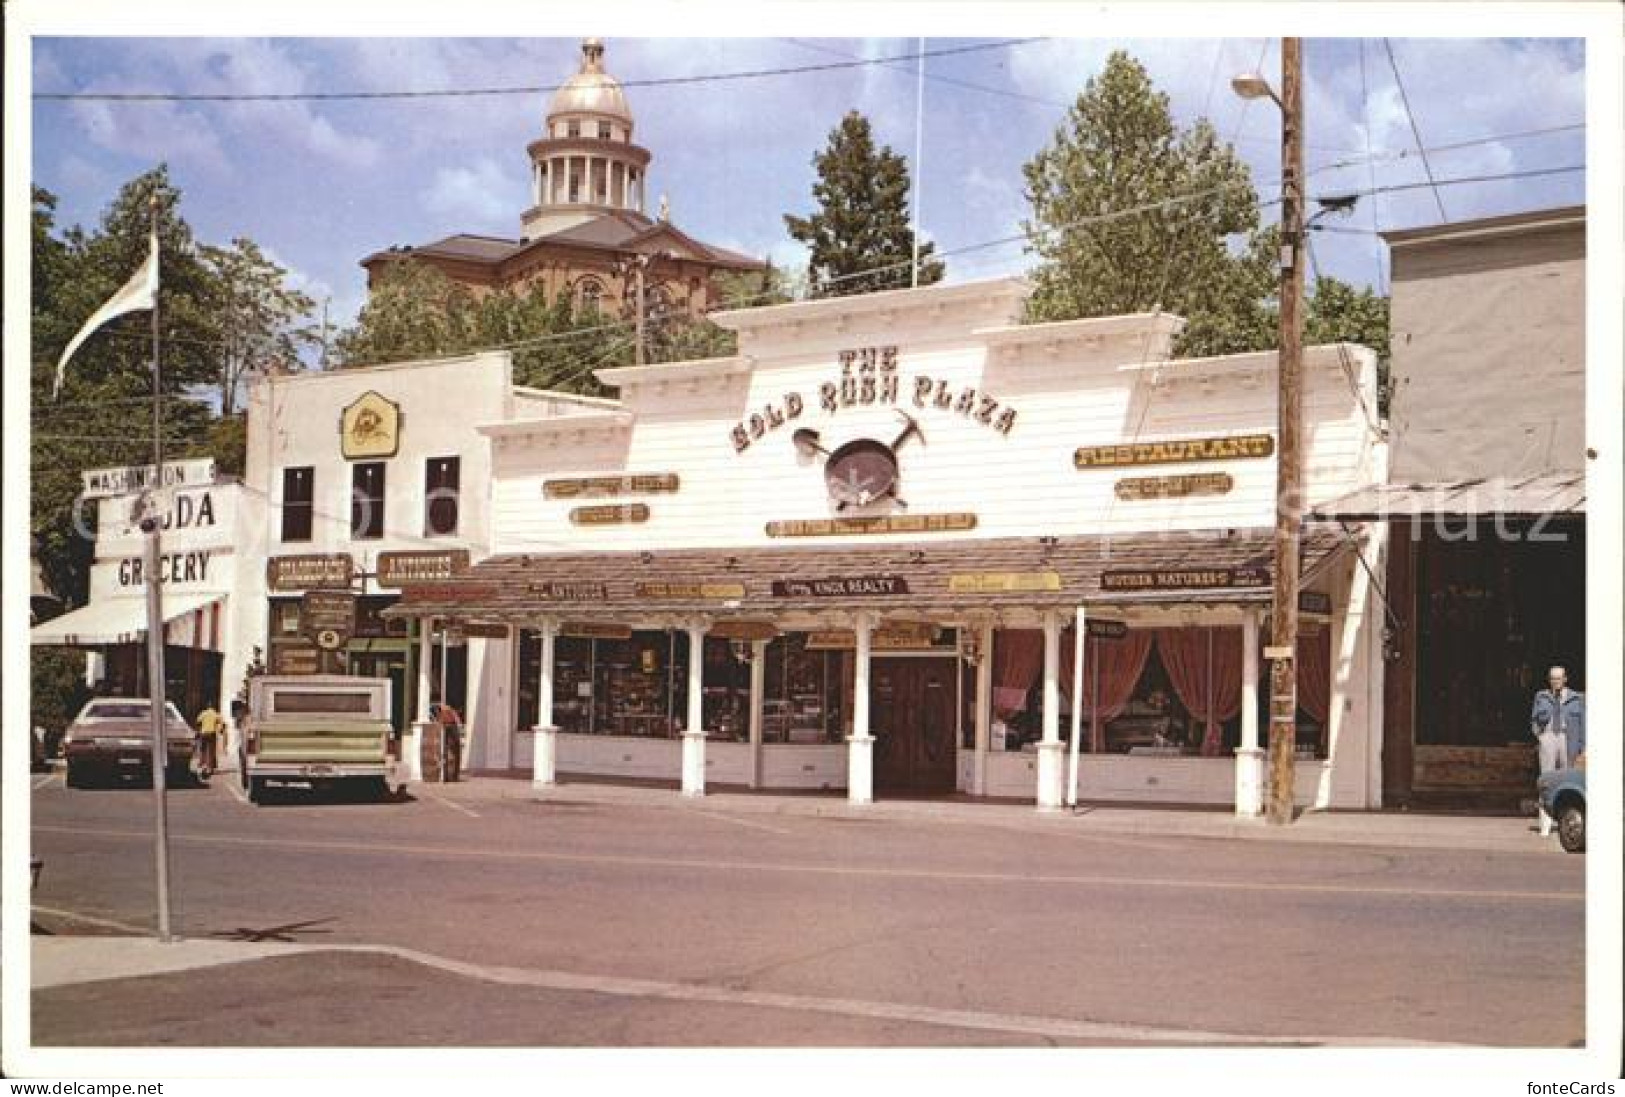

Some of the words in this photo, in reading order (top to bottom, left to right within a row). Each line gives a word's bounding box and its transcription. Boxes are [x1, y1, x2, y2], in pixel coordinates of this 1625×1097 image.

[838, 346, 899, 374] THE
[729, 391, 804, 455] GOLD
[818, 375, 899, 414] RUSH
[914, 375, 1018, 435] PLAZA
[1077, 437, 1269, 465] RESTAURANT
[90, 465, 185, 490] WASHINGON
[120, 551, 210, 586] GRCERY
[848, 578, 894, 593] REALTY
